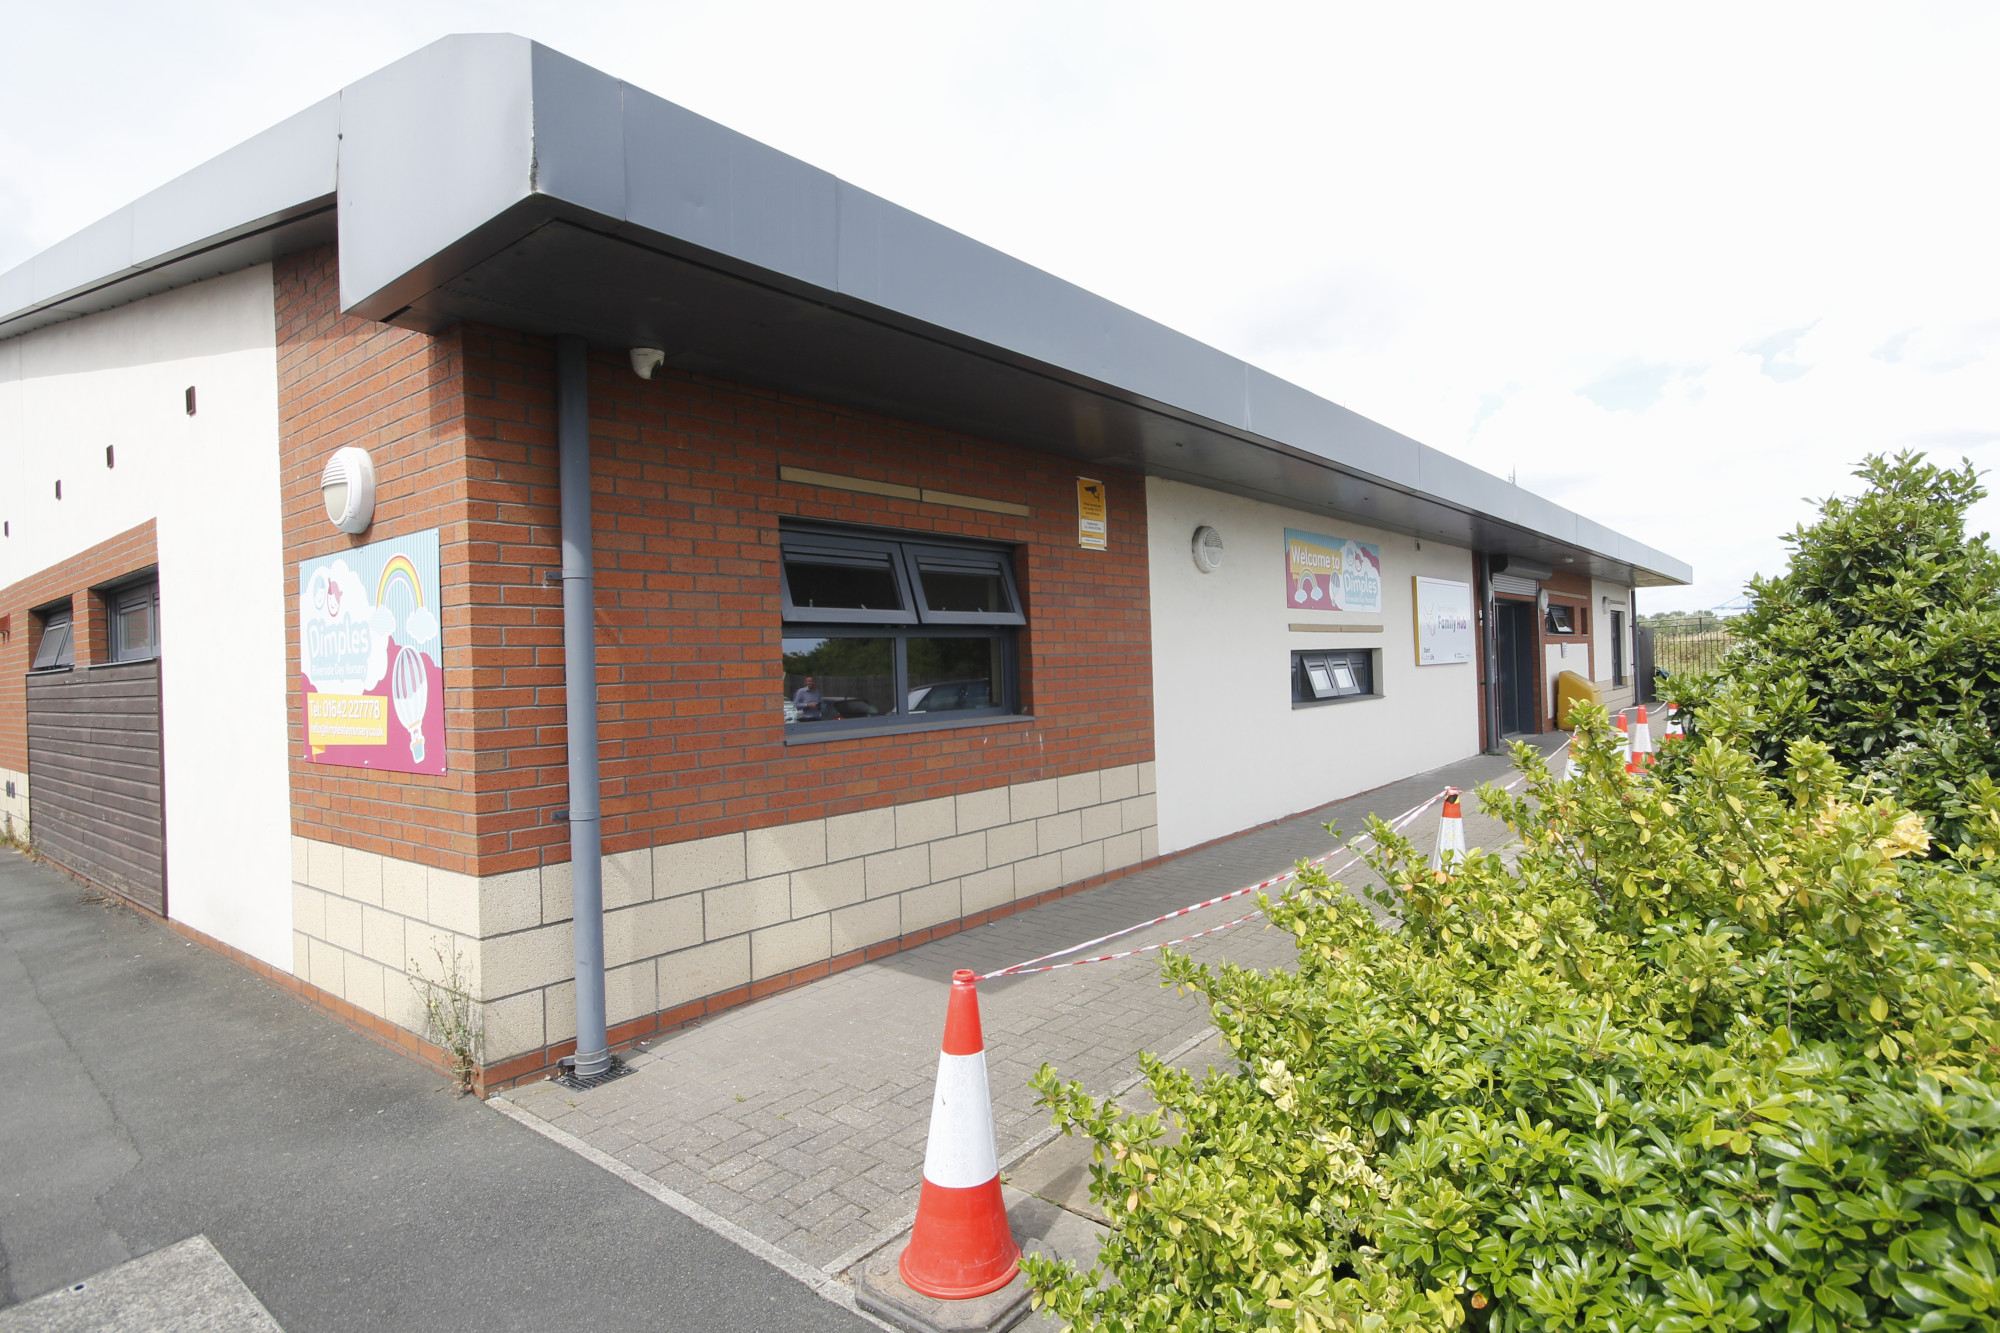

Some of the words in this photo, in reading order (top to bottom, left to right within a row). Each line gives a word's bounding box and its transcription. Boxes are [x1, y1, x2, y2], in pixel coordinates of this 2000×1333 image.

[1291, 545, 1331, 568] Welcome
[1332, 553, 1341, 570] to
[1344, 573, 1377, 596] Dimples
[1438, 615, 1456, 633] Family
[1457, 616, 1467, 630] Hub
[309, 618, 369, 663] Dimples
[335, 664, 344, 678] Day
[345, 664, 367, 677] Nursery
[309, 700, 322, 718] Tel:
[323, 700, 347, 719] 01642
[348, 700, 381, 720] 227778
